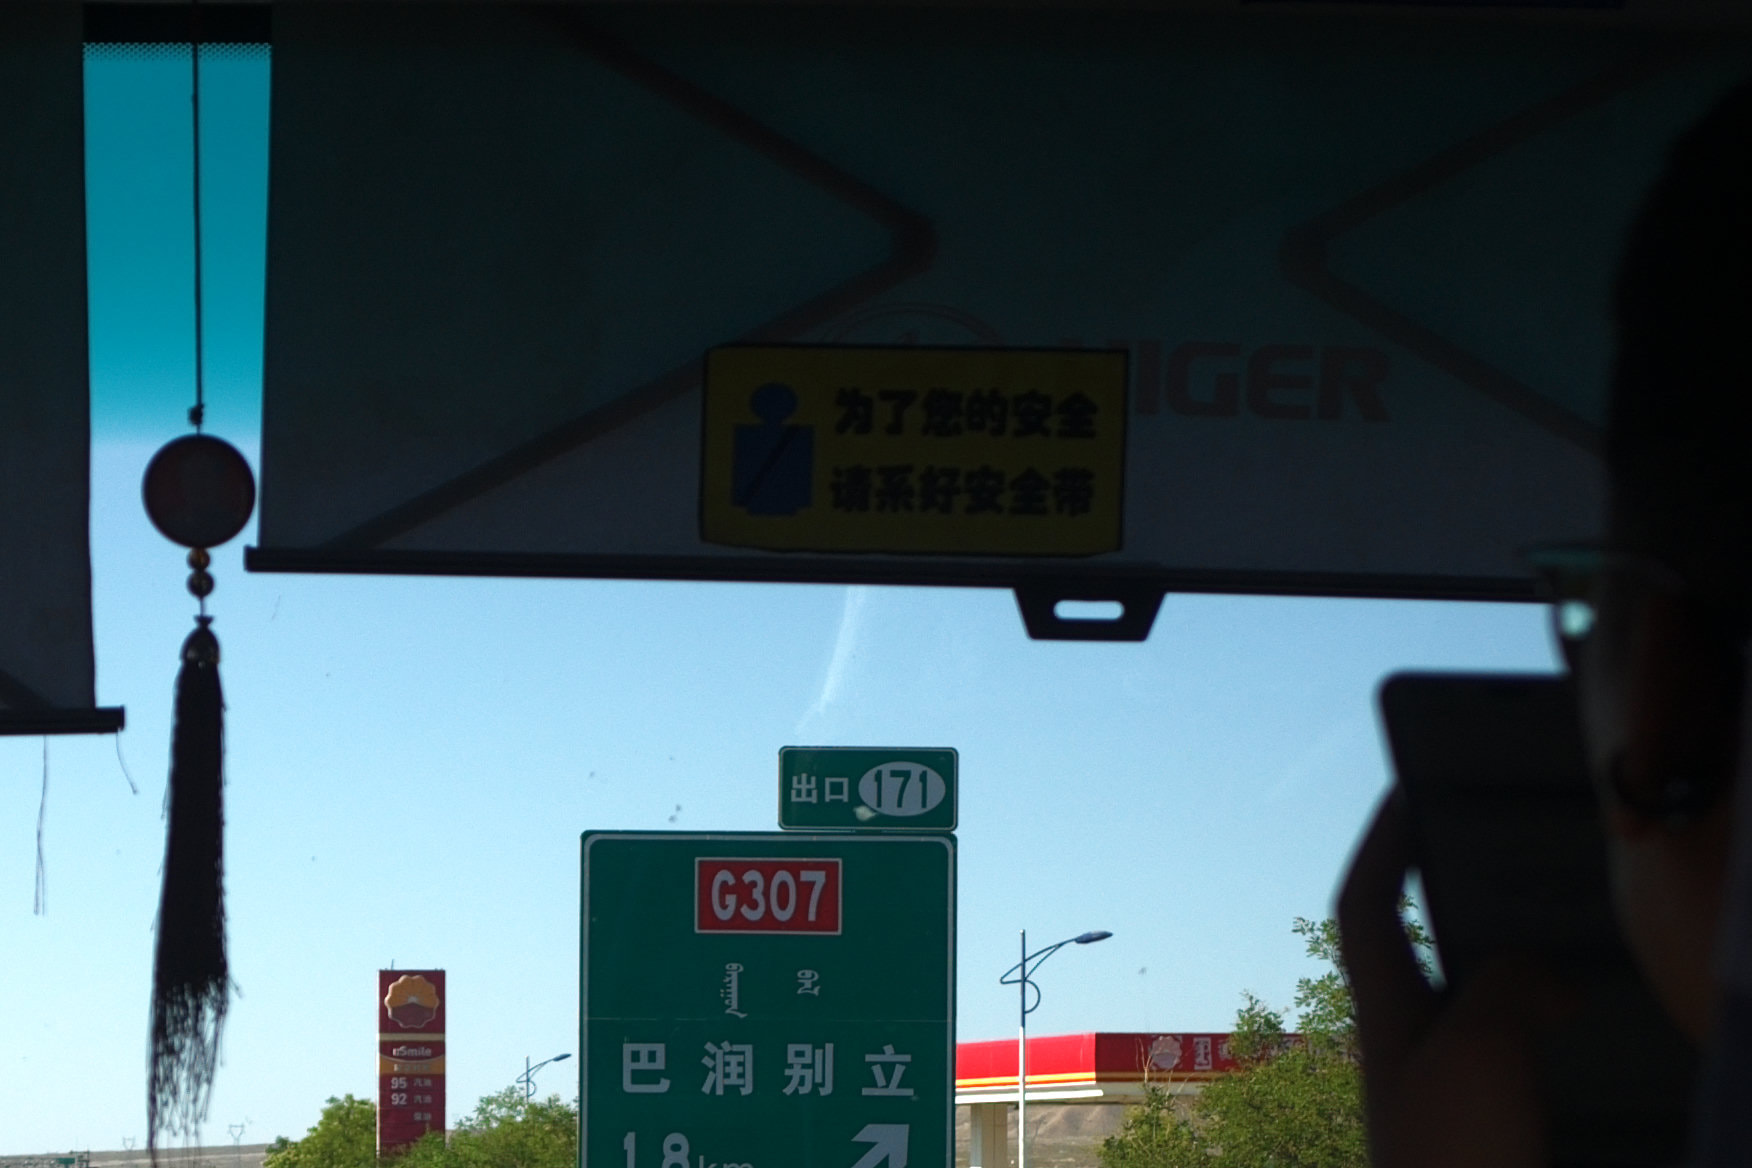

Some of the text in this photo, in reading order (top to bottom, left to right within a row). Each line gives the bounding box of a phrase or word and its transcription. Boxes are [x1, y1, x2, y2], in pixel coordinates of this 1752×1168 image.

[1118, 340, 1392, 422] IGER
[833, 387, 1098, 438] 为了您的安全
[830, 464, 1095, 516] 请系好安全带
[790, 769, 929, 809] 出口 171
[711, 869, 827, 922] G307
[391, 1077, 407, 1089] 95
[622, 1040, 915, 1096] 巴润别立
[391, 1093, 407, 1105] 92
